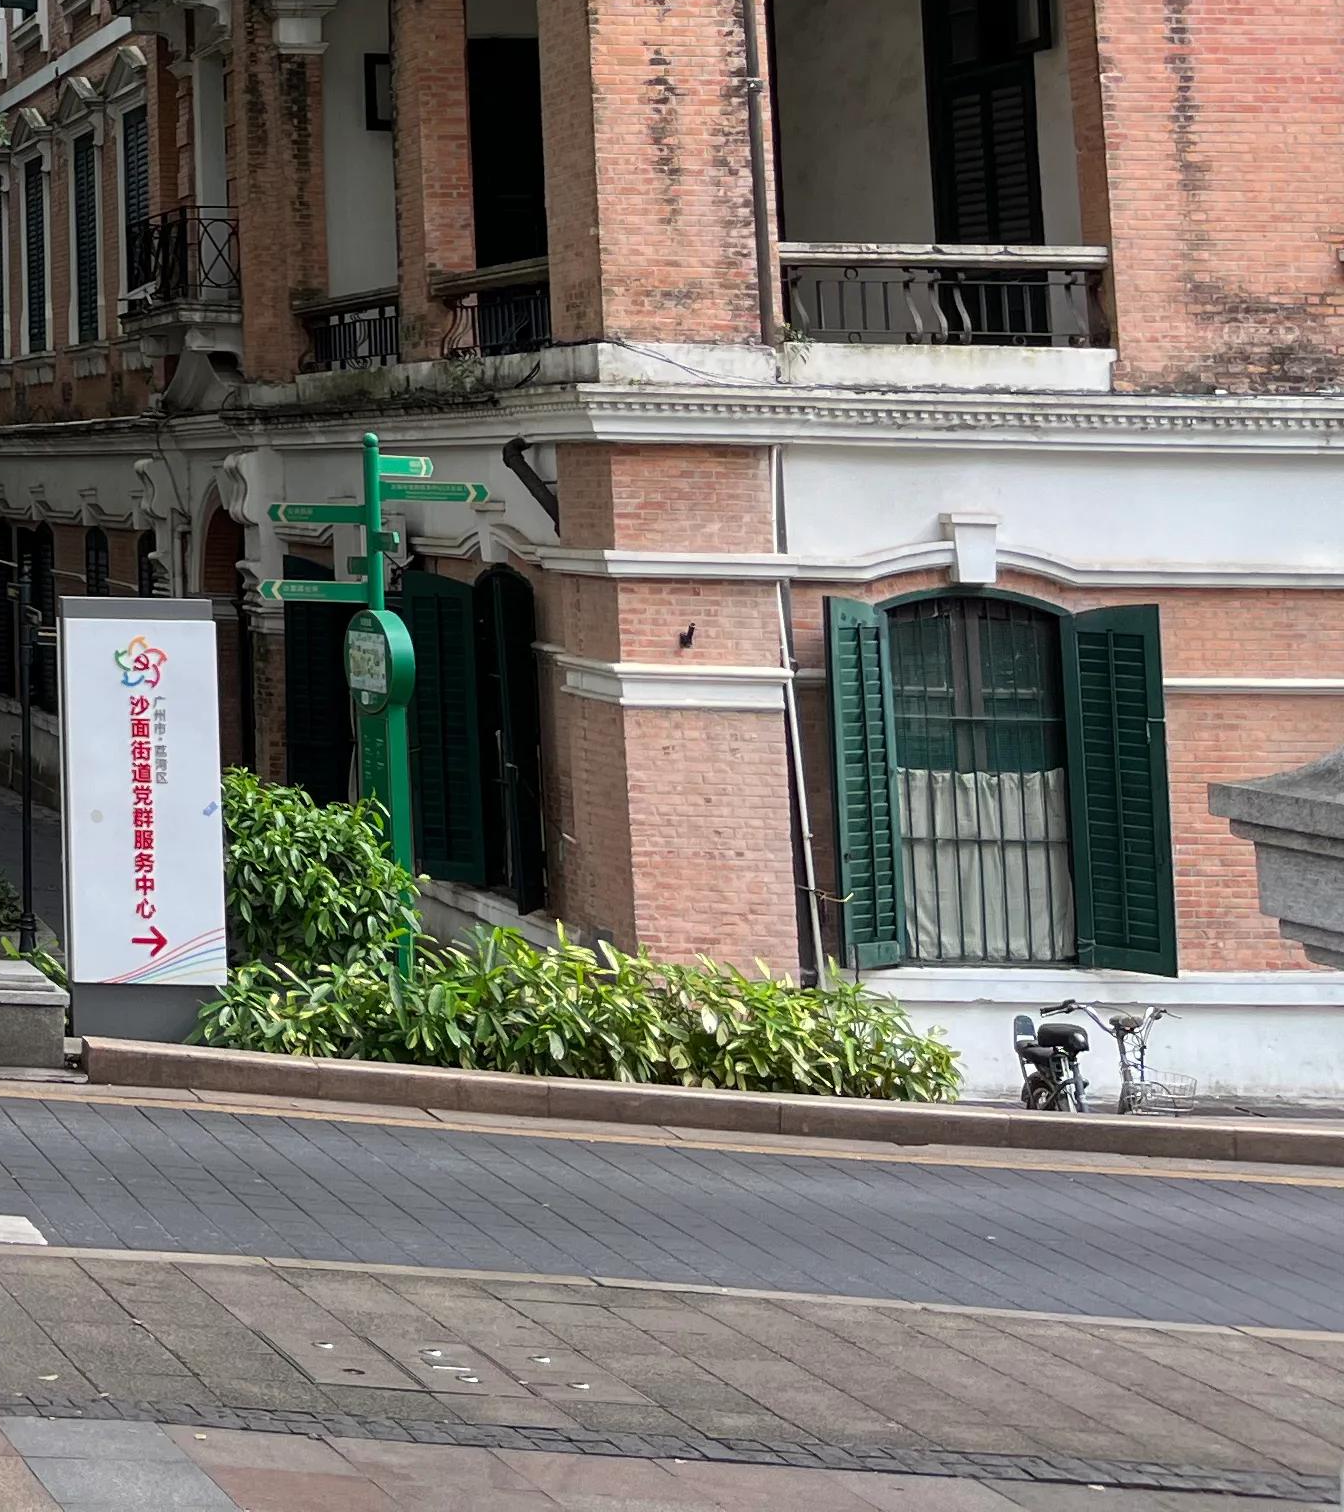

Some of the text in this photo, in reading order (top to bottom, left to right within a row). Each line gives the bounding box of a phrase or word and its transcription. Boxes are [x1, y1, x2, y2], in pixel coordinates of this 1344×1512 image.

[129, 695, 157, 920] 沙面街道党群服务中心
